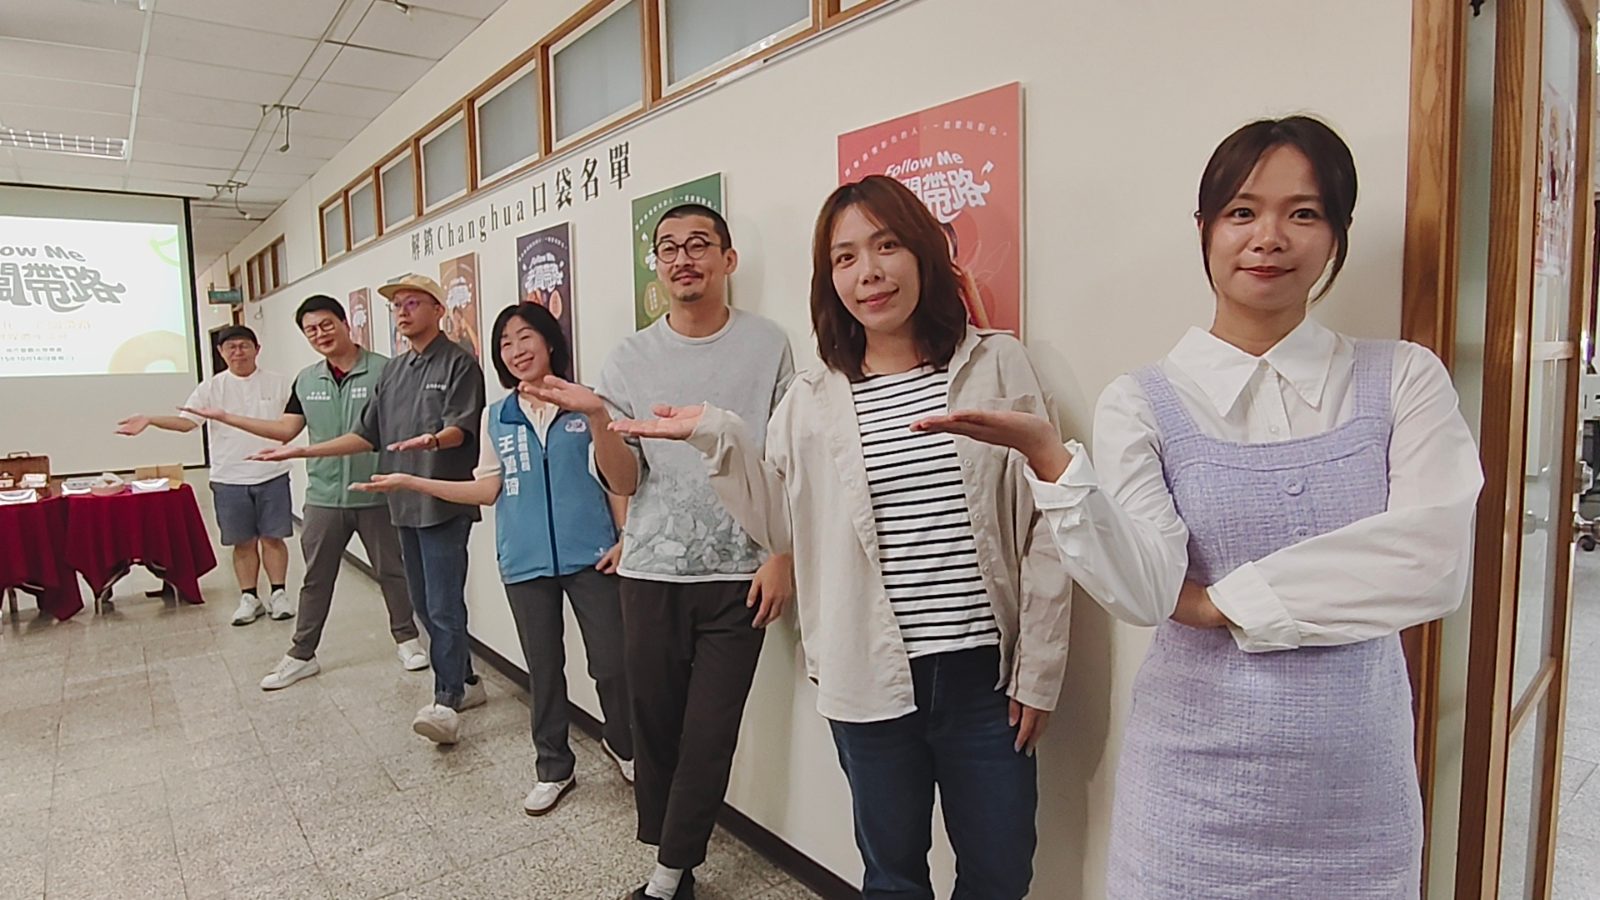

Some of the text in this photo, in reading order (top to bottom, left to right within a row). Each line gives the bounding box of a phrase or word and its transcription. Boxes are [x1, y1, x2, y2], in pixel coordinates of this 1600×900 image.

[884, 150, 965, 178] Follow Me
[44, 245, 86, 262] Me
